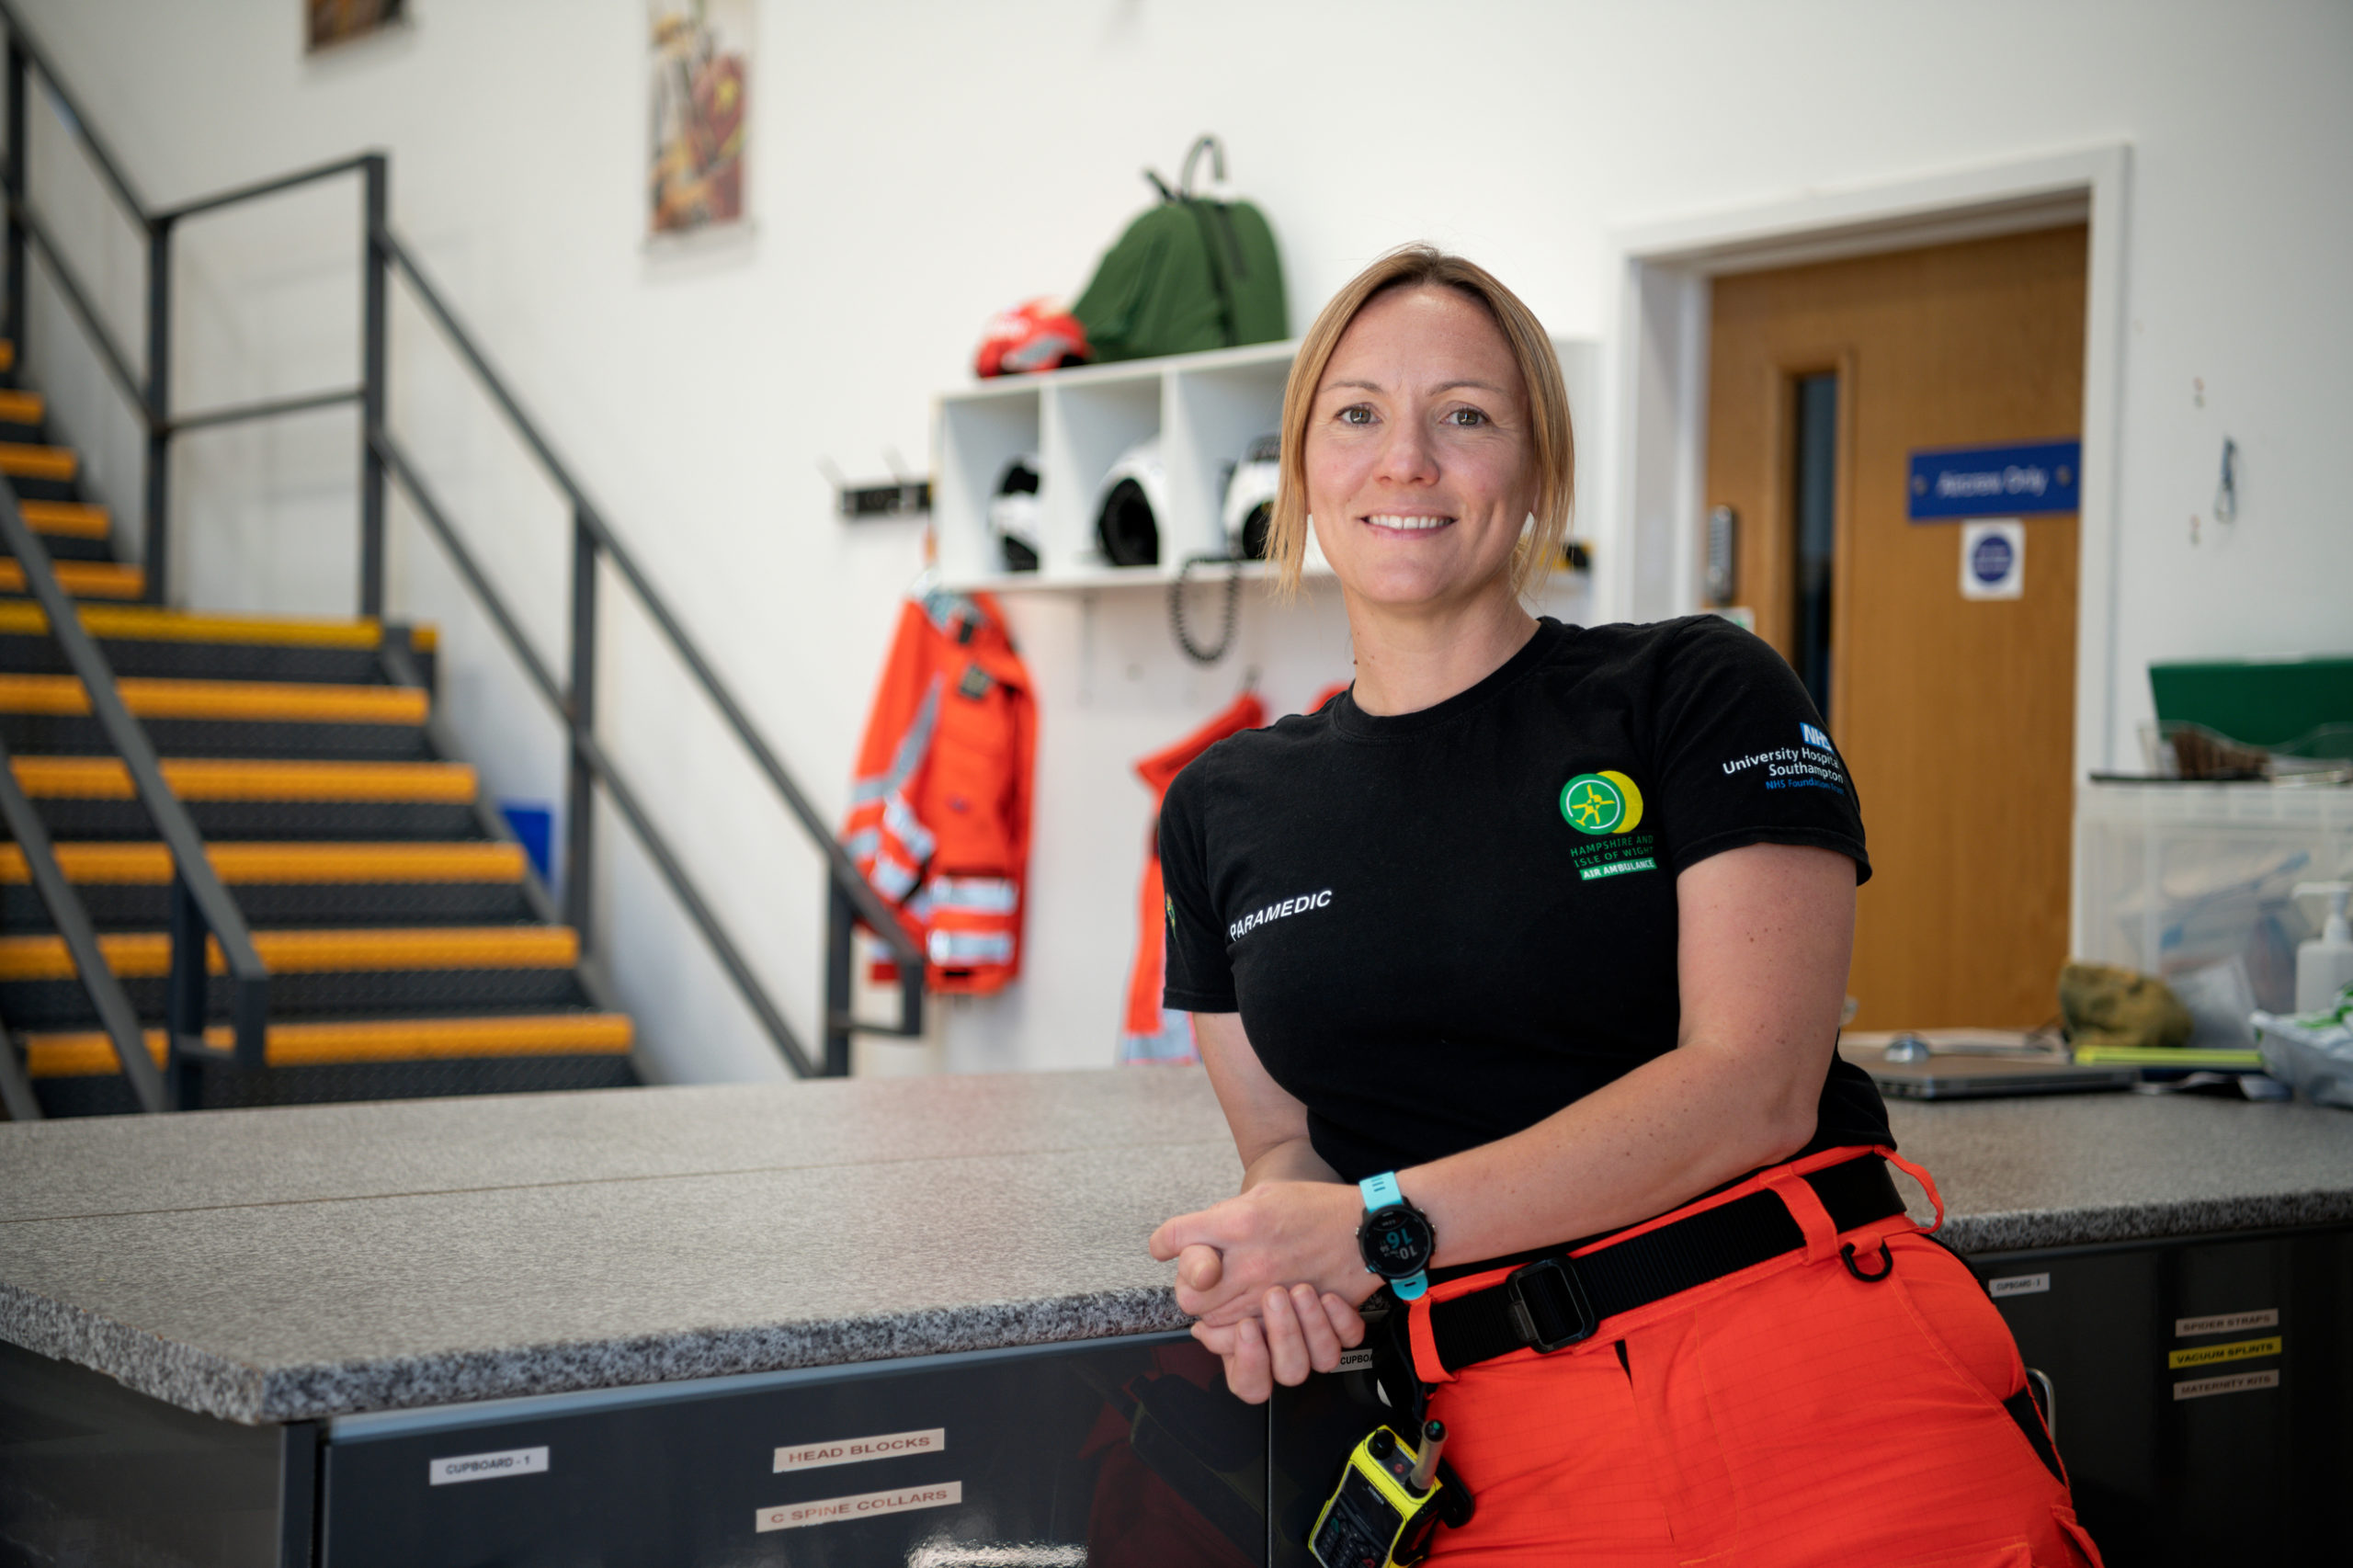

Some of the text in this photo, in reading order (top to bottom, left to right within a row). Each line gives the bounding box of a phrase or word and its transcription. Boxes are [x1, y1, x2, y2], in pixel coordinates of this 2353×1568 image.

[2003, 464, 2049, 497] Only
[1803, 724, 1832, 752] NHS
[1722, 747, 1799, 775] University
[1768, 762, 1844, 784] Southampton
[1766, 780, 1786, 790] NHS
[1570, 835, 1654, 858] HAMPSHIRE AND
[1574, 846, 1654, 868] ISLE OF WIGHT
[1583, 859, 1654, 879] AIR AMBULANCE
[1230, 890, 1333, 942] PARAMEDIC
[1386, 1228, 1413, 1250] 16
[2183, 1314, 2270, 1332] SPIDER STRAPS
[2176, 1343, 2274, 1364] VACUUM SPLINTS
[2181, 1375, 2271, 1394] MATERNITY KITS
[789, 1437, 931, 1463] HEAD BLOCKS
[445, 1458, 514, 1475] CUPBOARD
[524, 1455, 530, 1465] 1
[770, 1490, 948, 1524] C SPINE COLLARS
